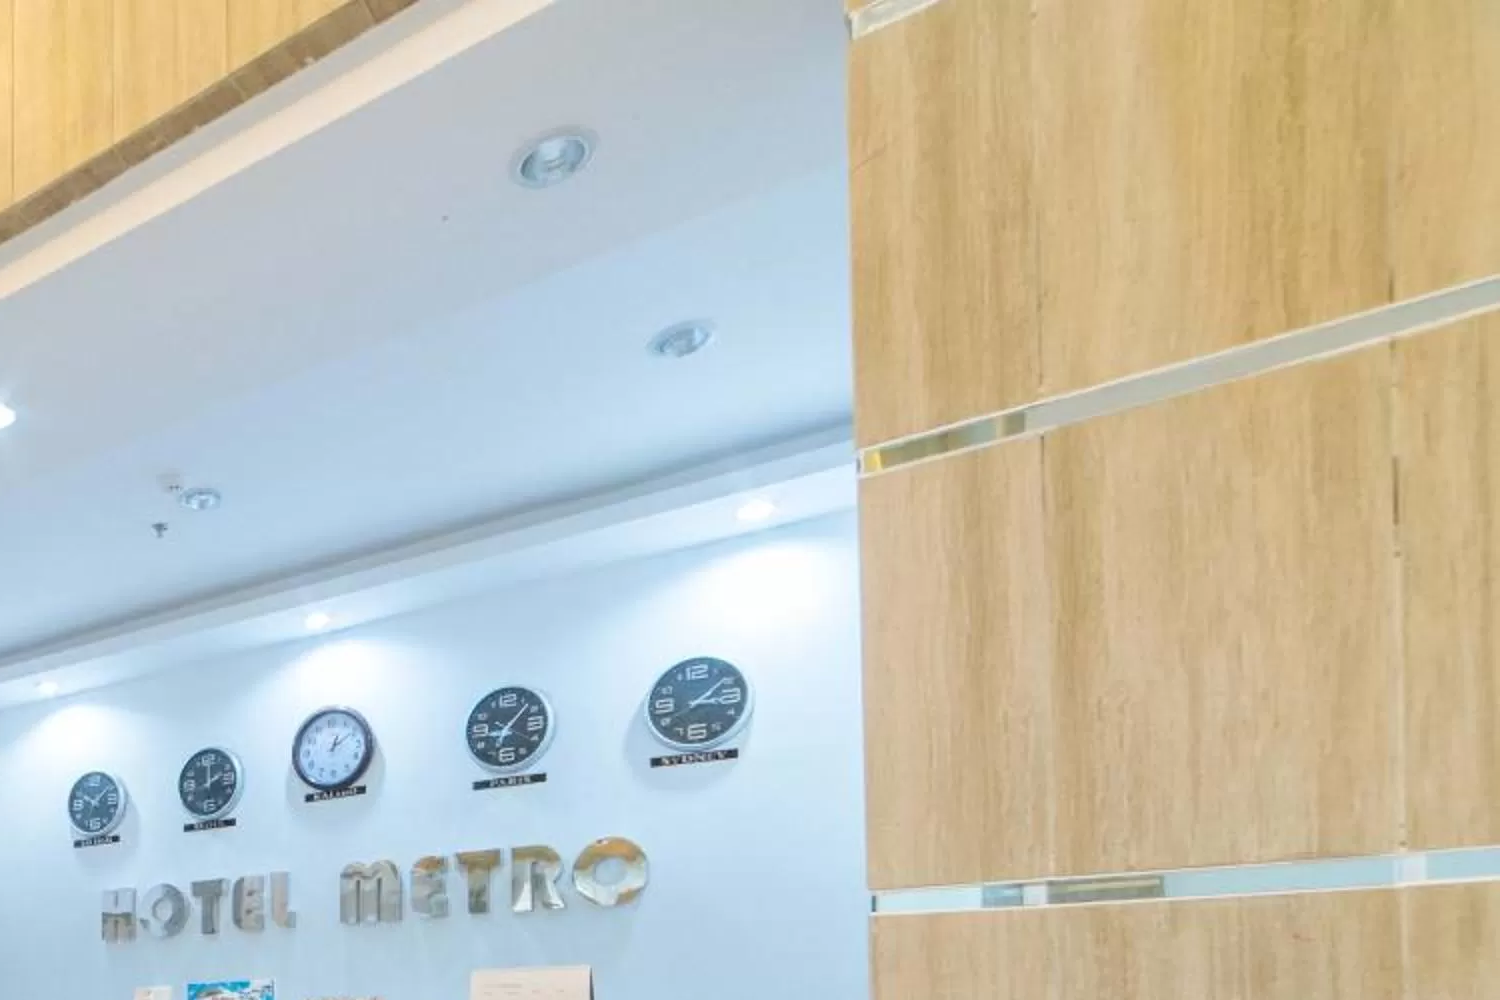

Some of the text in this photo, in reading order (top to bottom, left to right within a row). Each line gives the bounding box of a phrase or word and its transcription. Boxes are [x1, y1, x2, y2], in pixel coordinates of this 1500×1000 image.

[686, 664, 708, 680] 12
[661, 752, 727, 766] SYDNEY
[101, 836, 648, 943] HOTEL METRO
